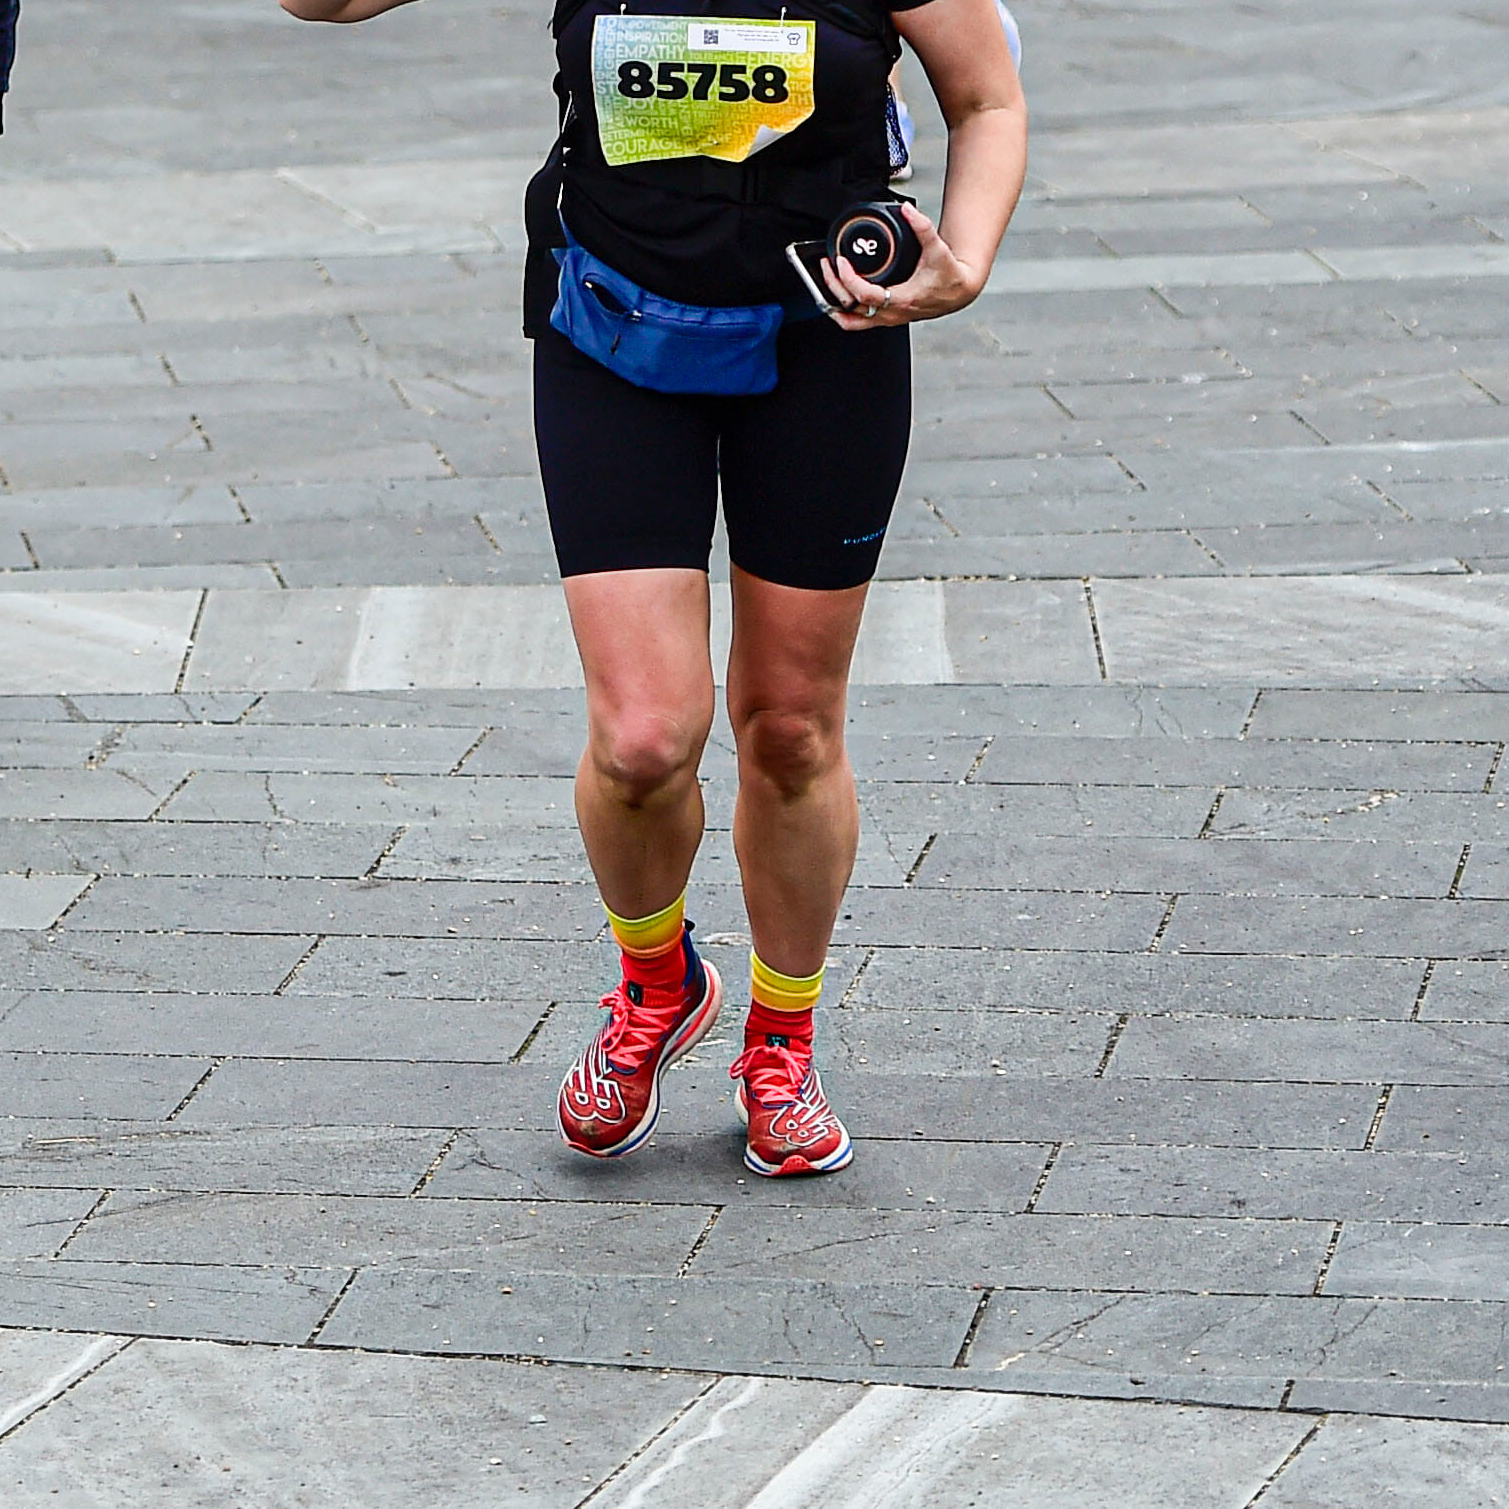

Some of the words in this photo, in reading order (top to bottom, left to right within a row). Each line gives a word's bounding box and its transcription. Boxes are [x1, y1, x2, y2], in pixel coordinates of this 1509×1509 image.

[617, 30, 687, 44] INSPIRATION
[617, 44, 687, 60] EMPATHY
[617, 60, 790, 104] 85758
[626, 116, 679, 129] WORTH
[603, 137, 683, 157] COURAGE
